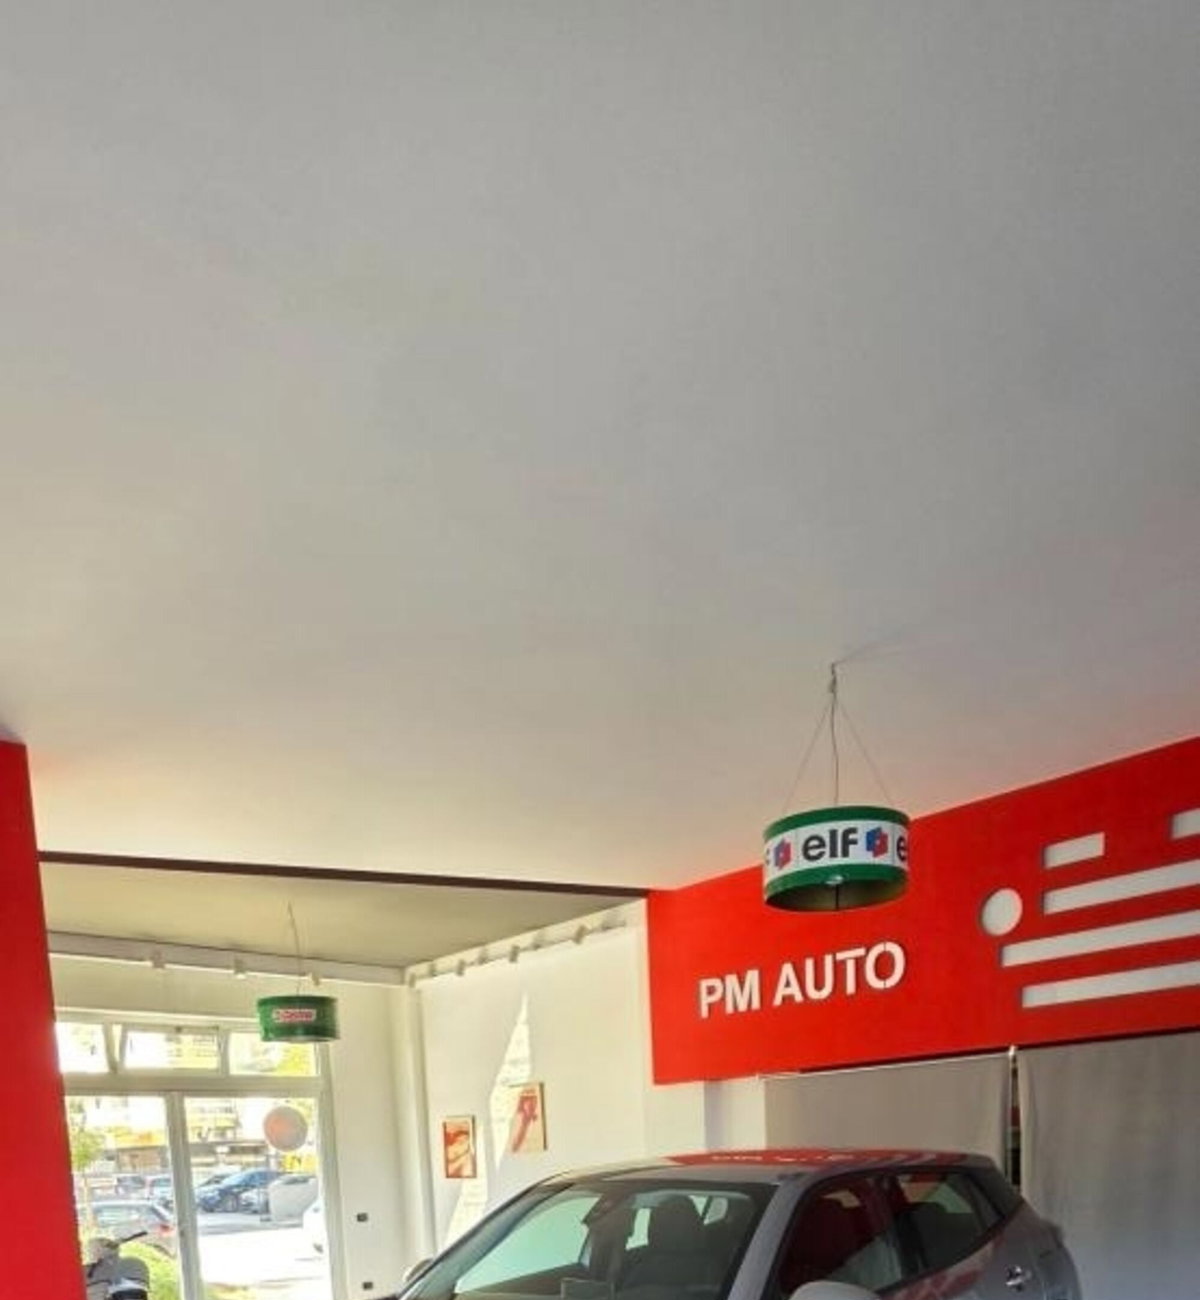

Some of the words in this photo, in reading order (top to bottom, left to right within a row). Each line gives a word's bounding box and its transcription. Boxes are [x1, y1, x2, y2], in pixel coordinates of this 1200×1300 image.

[802, 827, 859, 862] elf
[699, 969, 761, 1019] PM
[772, 941, 906, 1008] AUTO
